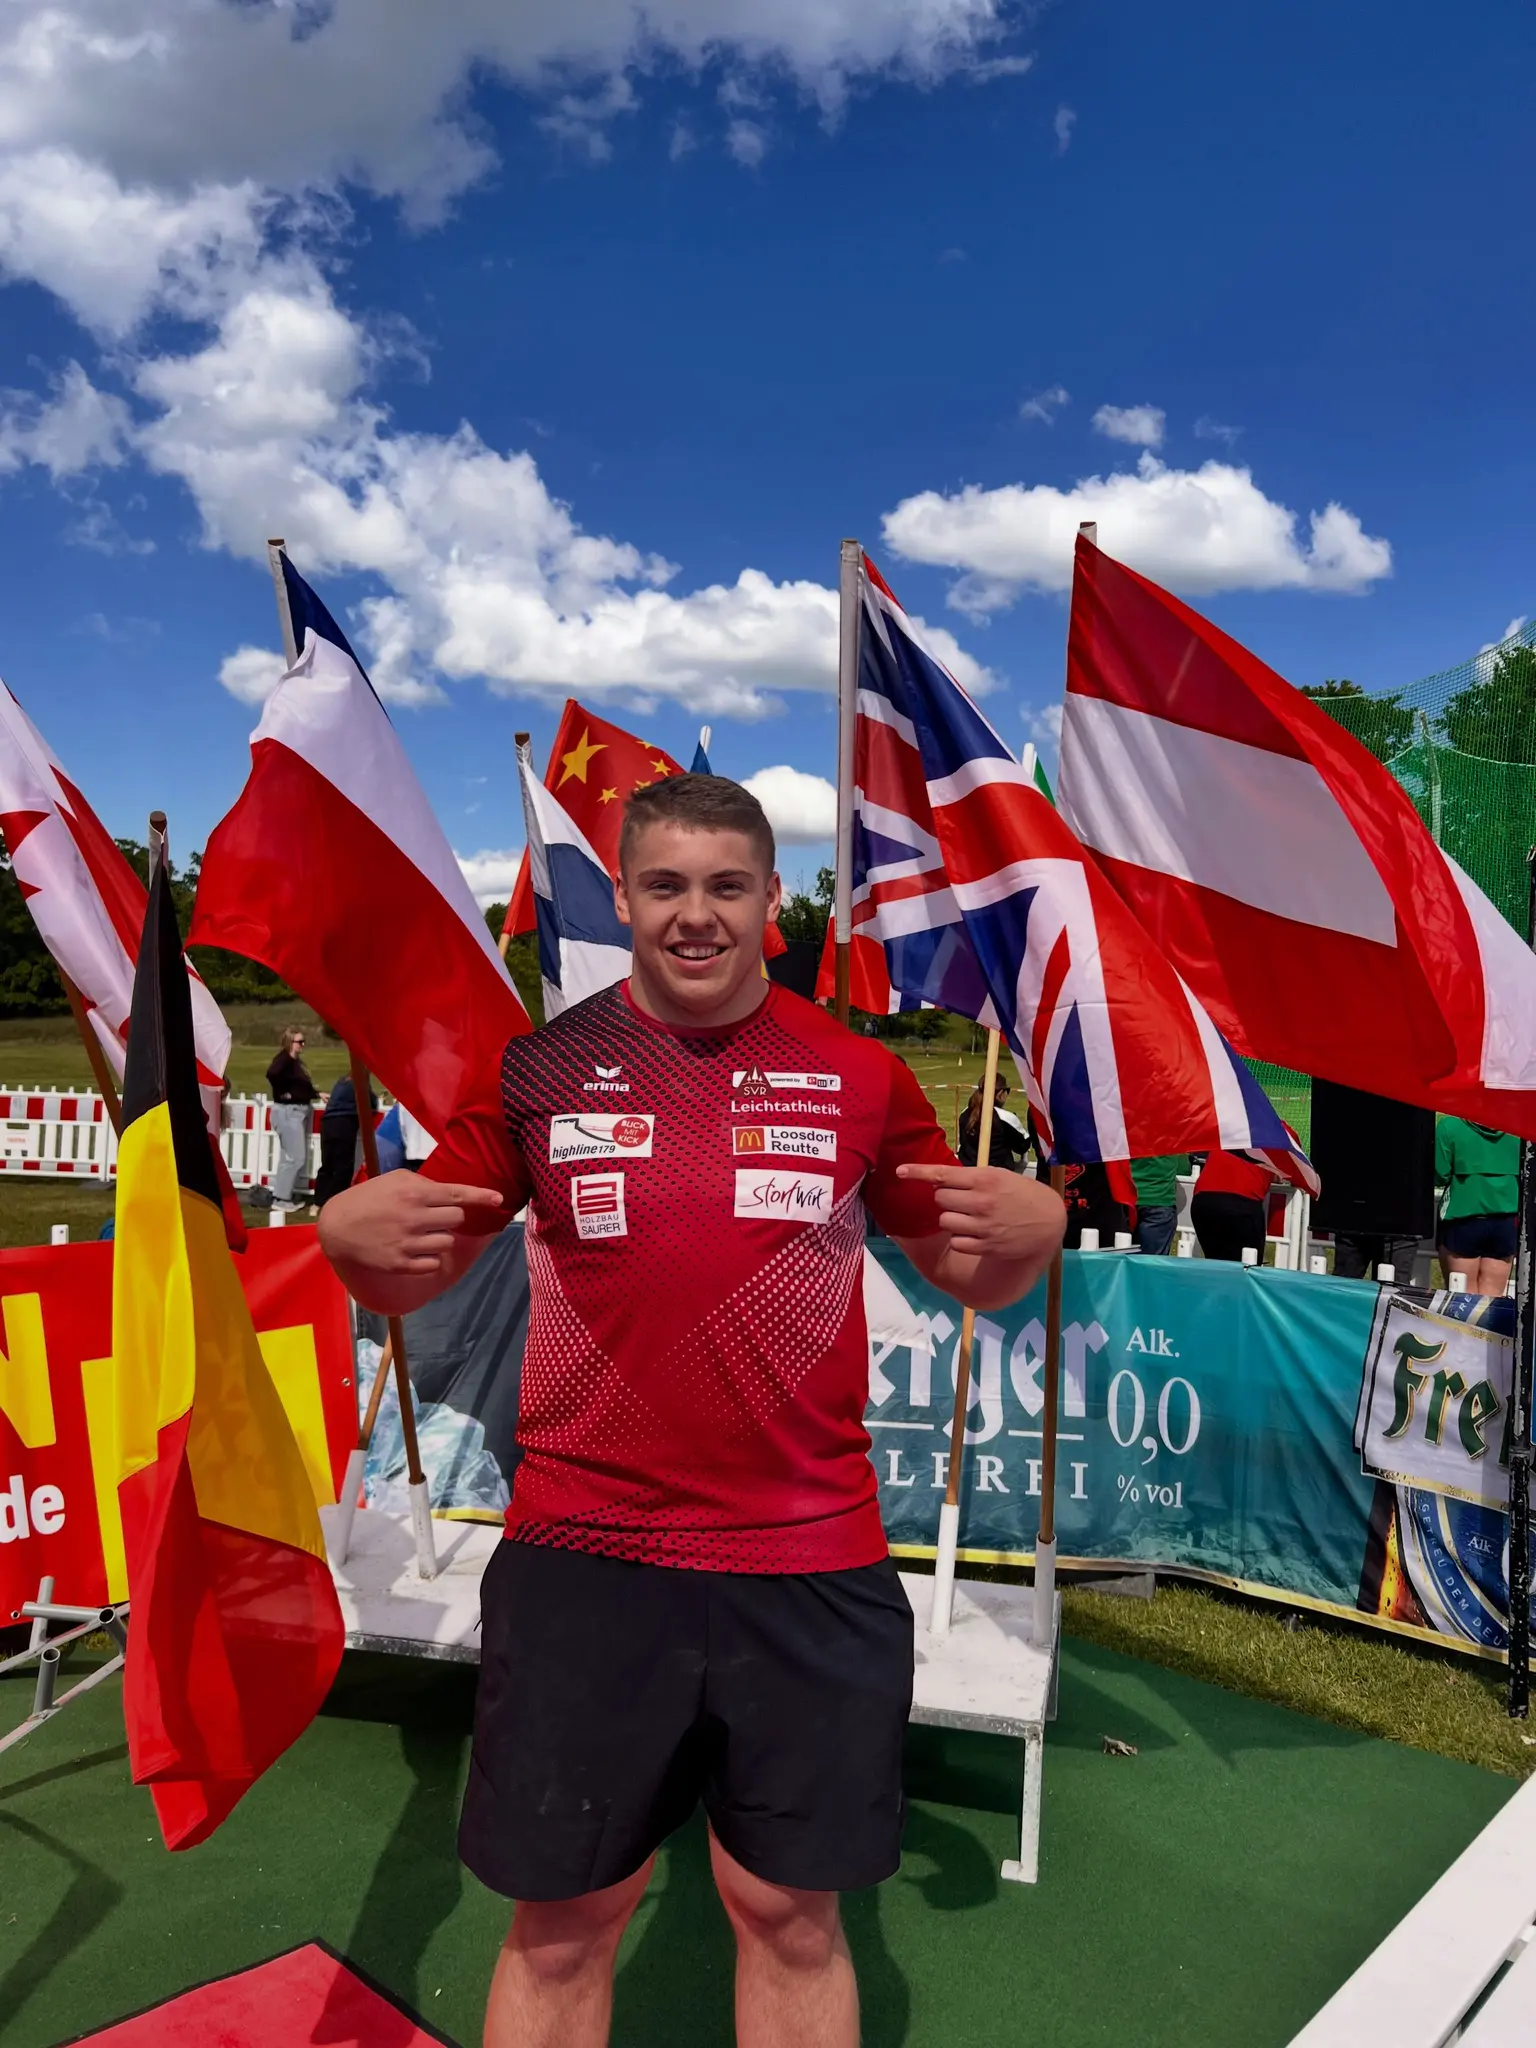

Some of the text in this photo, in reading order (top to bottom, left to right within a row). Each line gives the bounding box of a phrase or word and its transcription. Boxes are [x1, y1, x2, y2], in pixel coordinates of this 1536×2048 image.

[583, 1080, 630, 1092] erima
[743, 1086, 767, 1096] SVR
[731, 1100, 842, 1116] Leichtathletik
[620, 1120, 646, 1130] BLICK
[617, 1134, 640, 1145] KICK
[623, 1129, 639, 1137] MIT
[771, 1128, 835, 1144] Loosdorf
[771, 1141, 820, 1155] Reutte
[579, 1213, 619, 1224] HOLZBAU
[581, 1222, 621, 1235] SAURER
[1125, 1326, 1180, 1358] Alk.
[1382, 1331, 1513, 1467] Fre
[1107, 1369, 1201, 1466] 0,0
[1145, 1482, 1183, 1508] vol
[1467, 1535, 1495, 1555] Alk.
[1445, 1576, 1470, 1611] DEM
[1472, 1616, 1503, 1647] DEU
